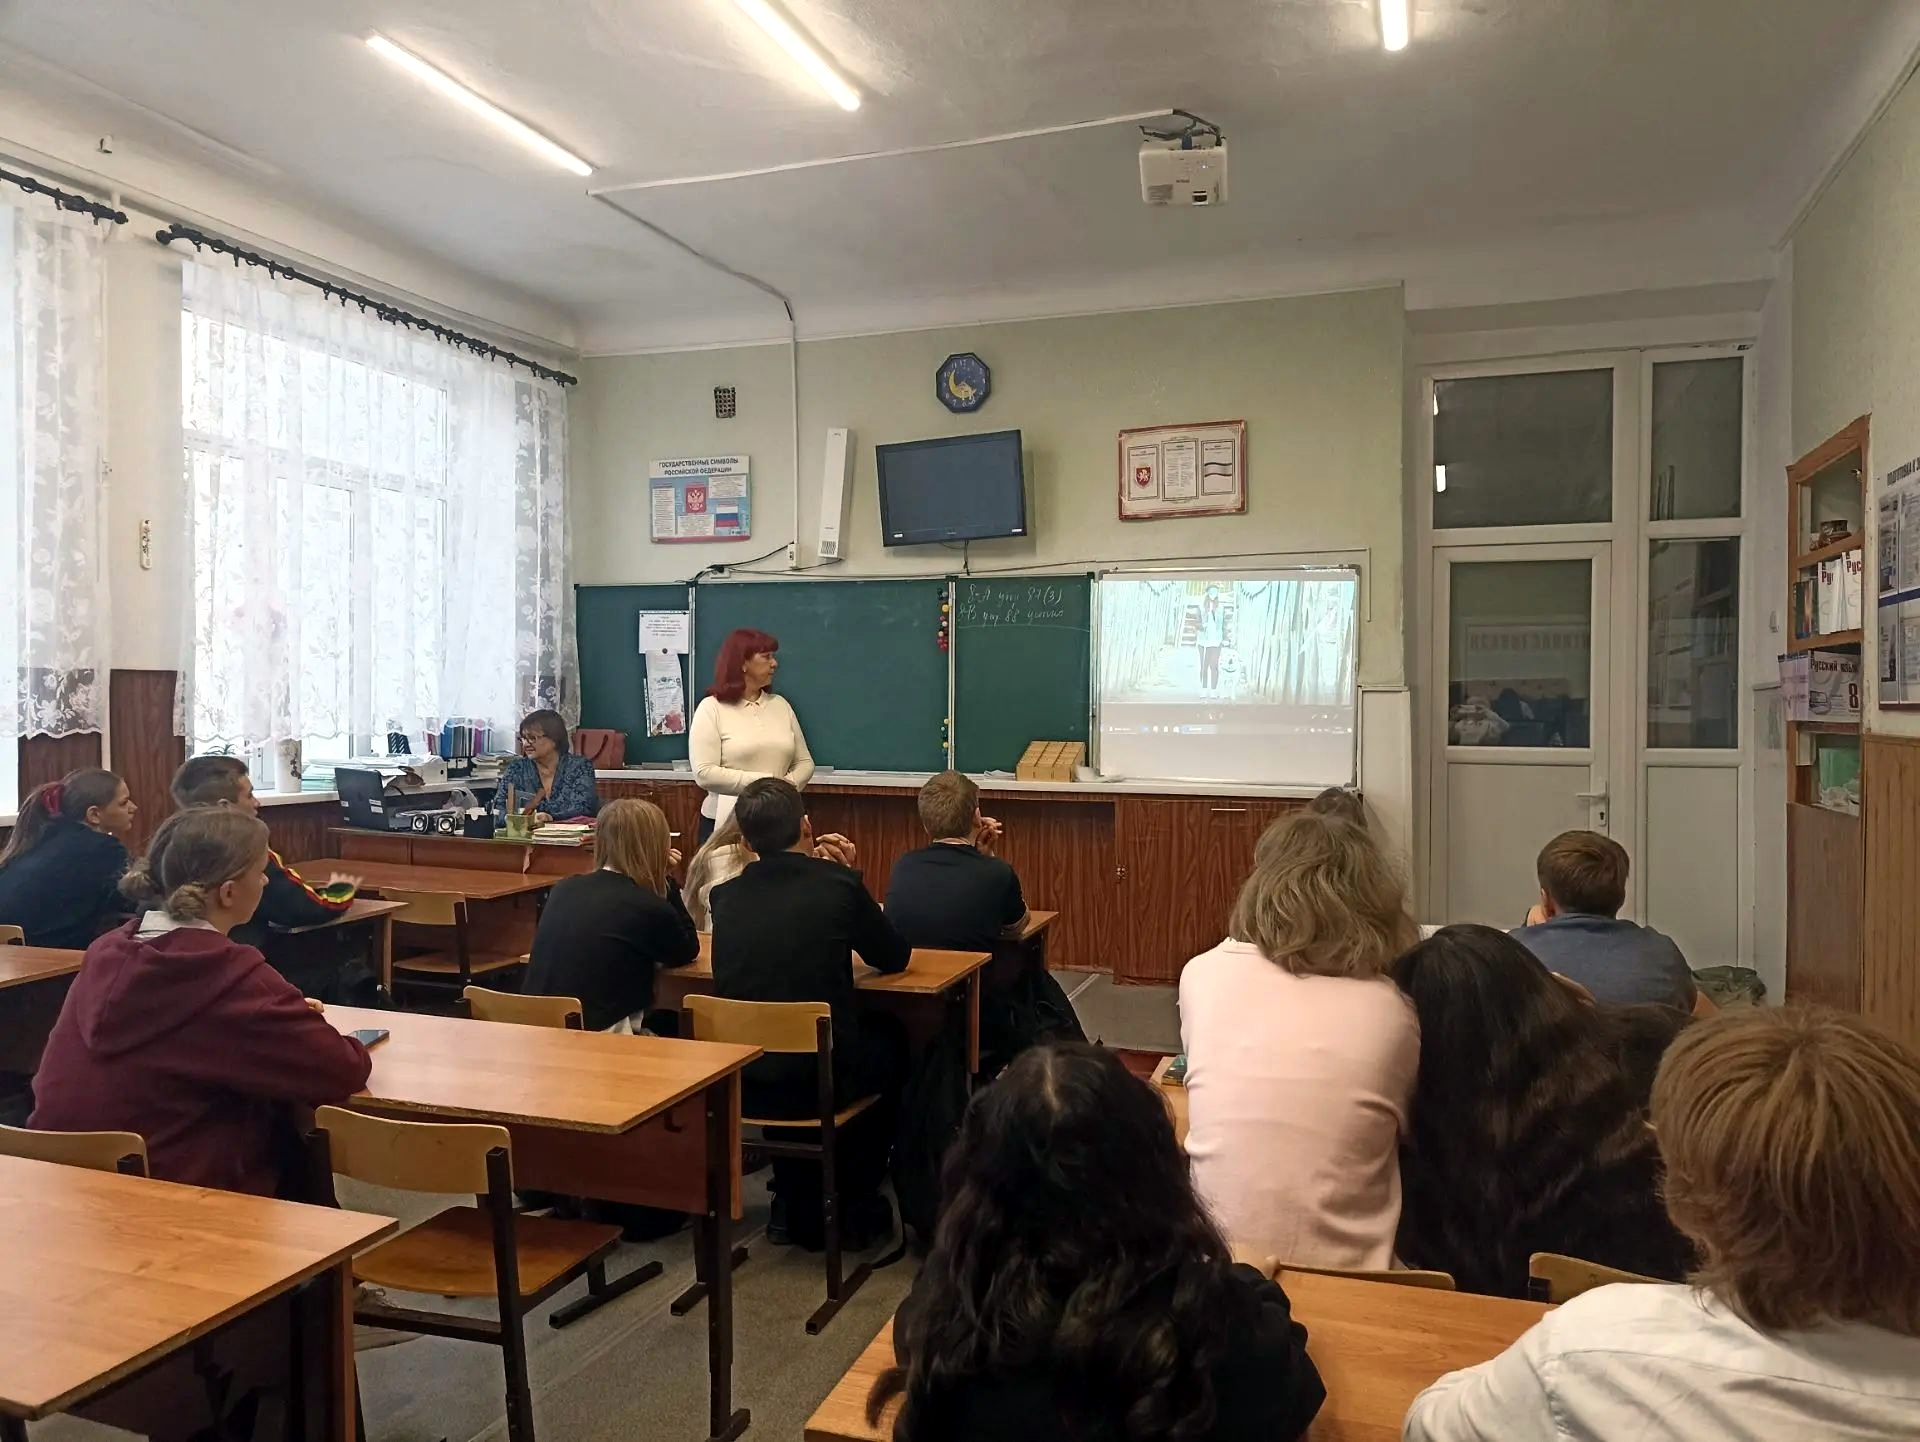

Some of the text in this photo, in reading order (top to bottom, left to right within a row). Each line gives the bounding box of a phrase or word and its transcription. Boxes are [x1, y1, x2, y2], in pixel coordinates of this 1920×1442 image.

[659, 457, 739, 468] ГОСУДАРСТВЕННЫЕ СИМВОЛЫ
[664, 466, 732, 476] РОССИЙСКОЙ ФЕДЕРАЦИИ
[1810, 659, 1838, 672] Русский
[1848, 683, 1859, 709] 8
